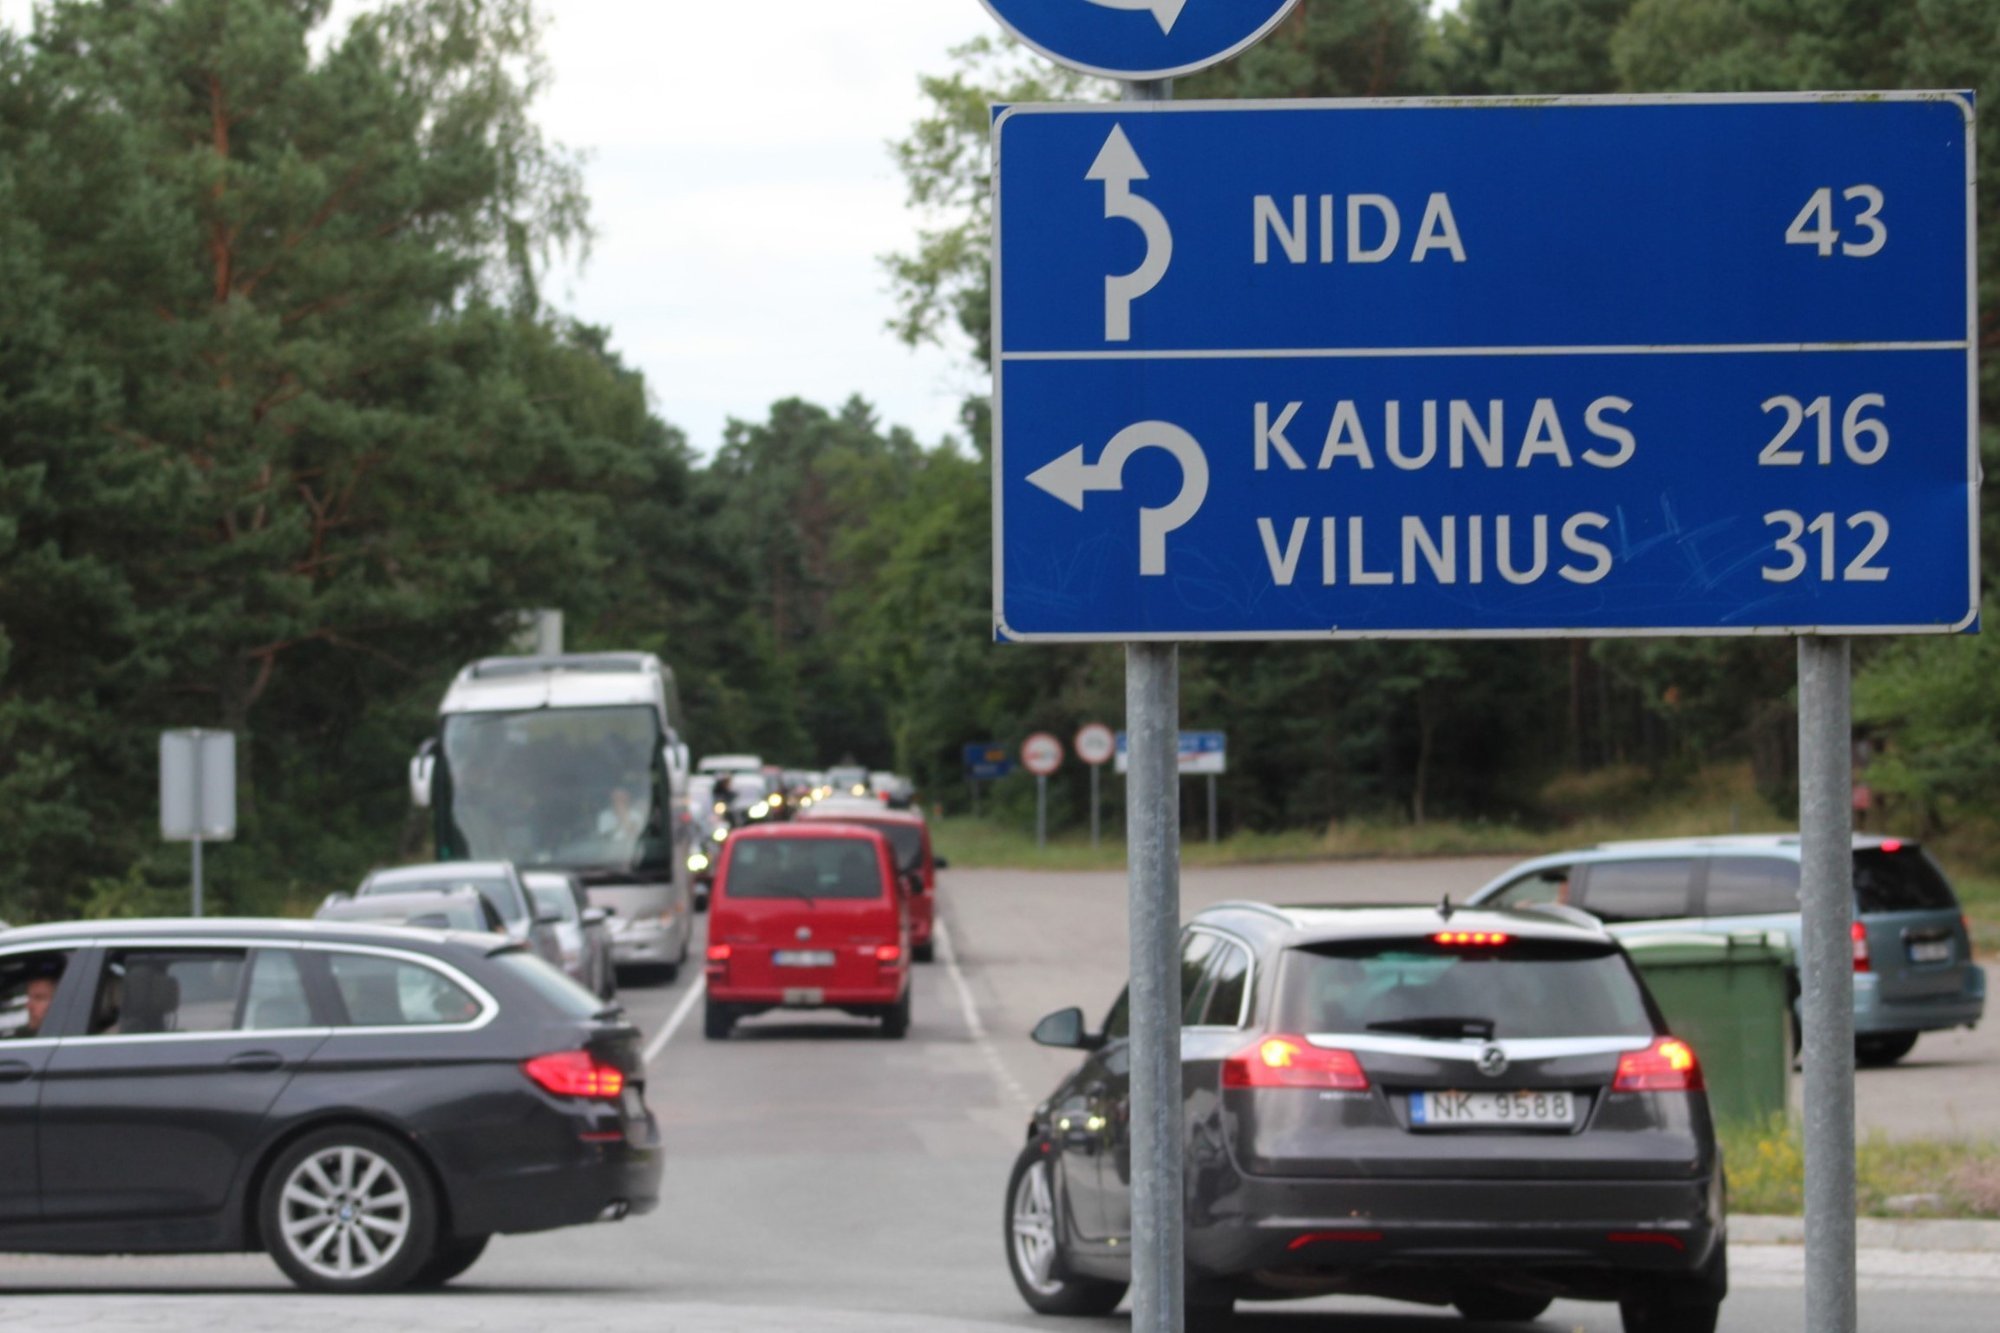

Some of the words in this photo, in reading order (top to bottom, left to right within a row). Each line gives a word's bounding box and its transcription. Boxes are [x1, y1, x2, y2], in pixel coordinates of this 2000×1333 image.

[1254, 192, 1467, 263] NIDA
[1785, 184, 1888, 257] 43
[1254, 396, 1636, 471] KAUNAS
[1758, 392, 1890, 467] 216
[1257, 511, 1614, 586] VILNIUS
[1761, 509, 1890, 583] 312
